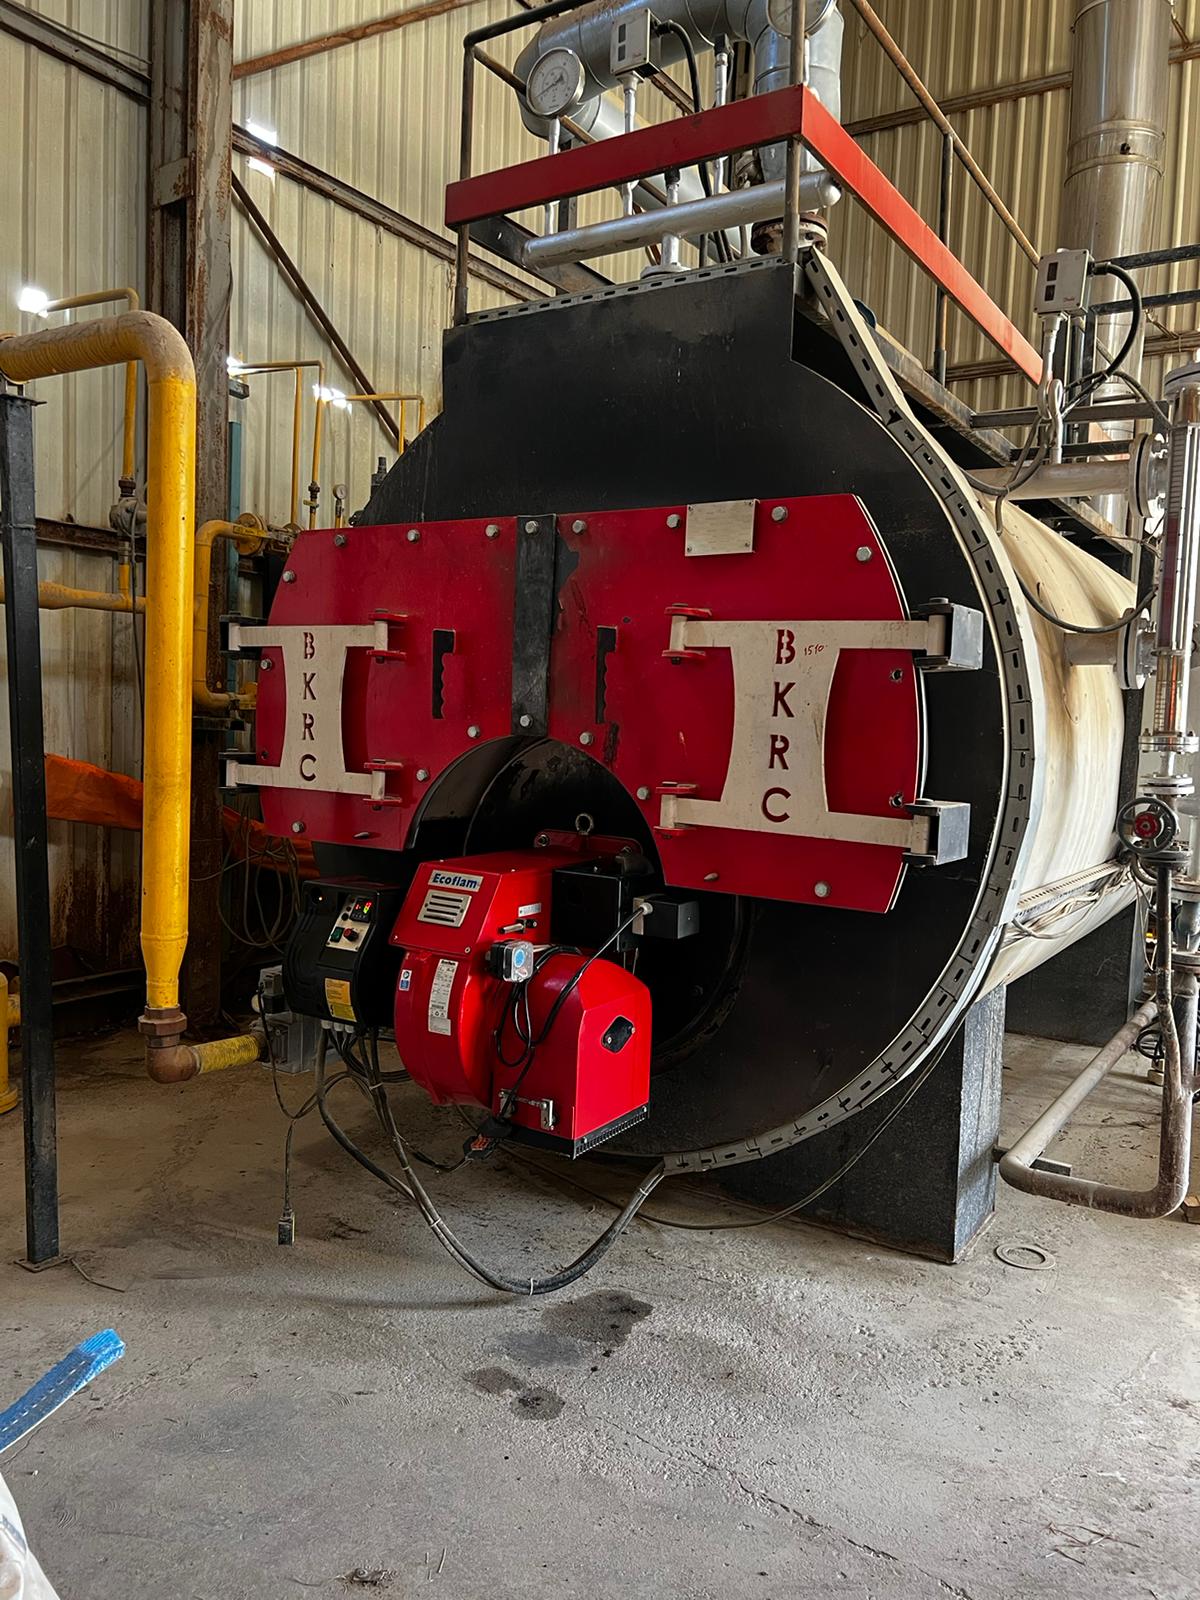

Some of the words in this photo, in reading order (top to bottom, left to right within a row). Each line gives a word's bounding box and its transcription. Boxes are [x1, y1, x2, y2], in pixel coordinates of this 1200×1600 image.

[299, 632, 317, 782] BKRC
[760, 628, 797, 824] BKRC
[432, 873, 478, 889] Ecoflam
